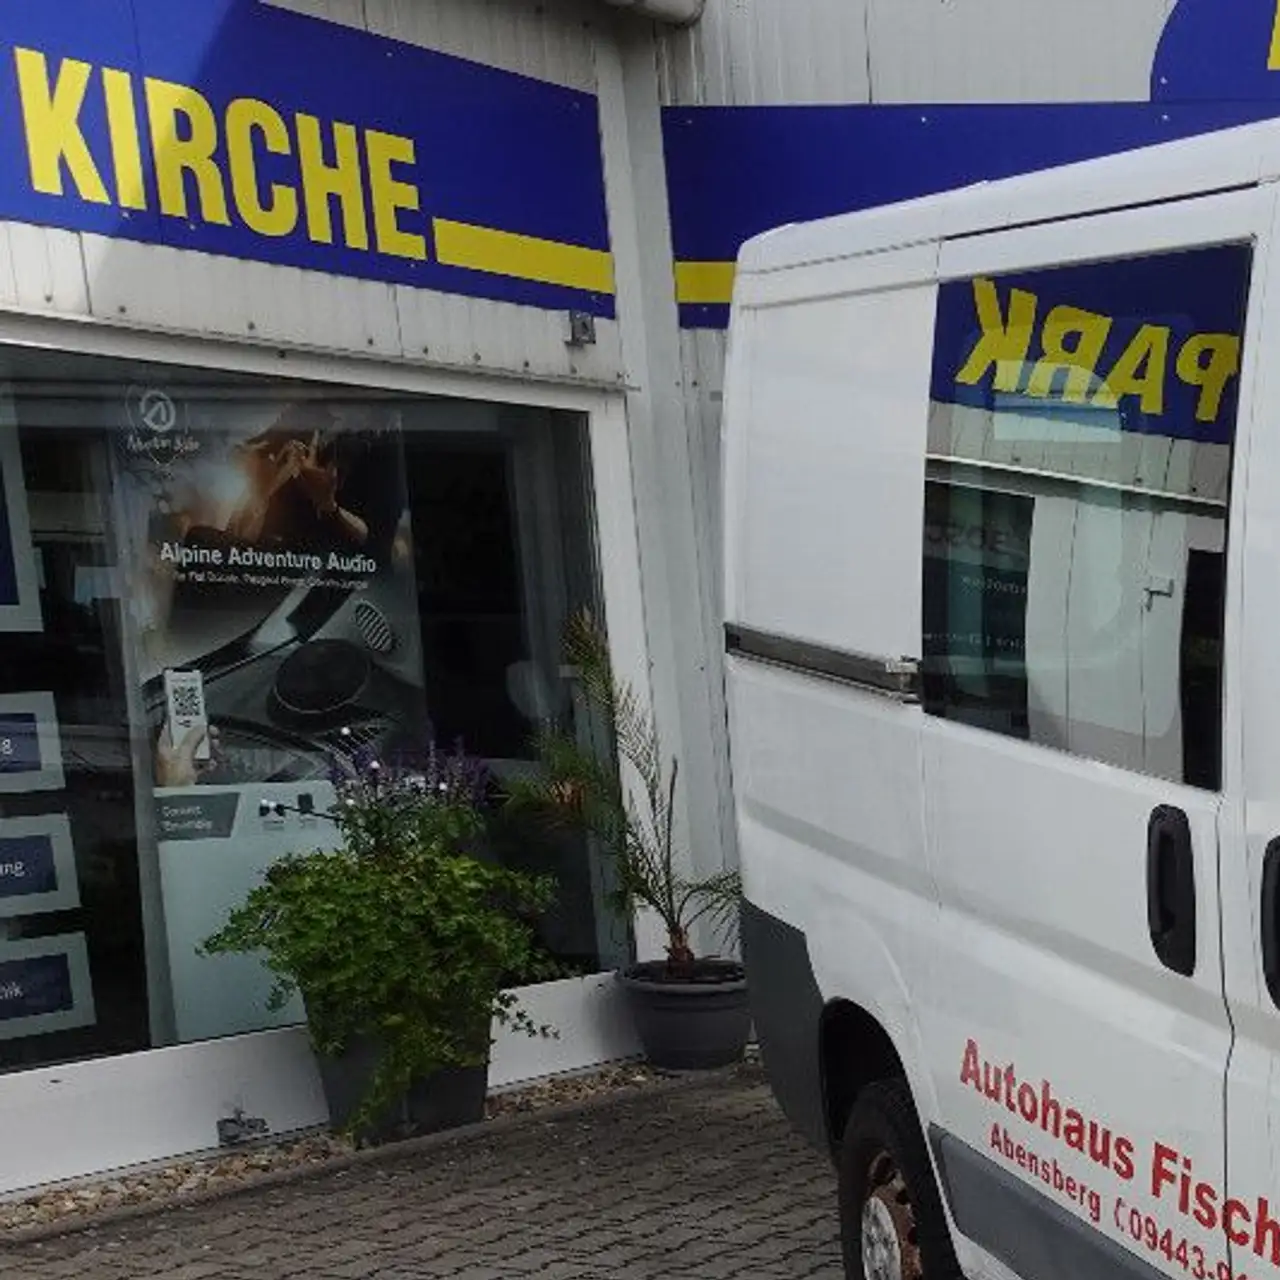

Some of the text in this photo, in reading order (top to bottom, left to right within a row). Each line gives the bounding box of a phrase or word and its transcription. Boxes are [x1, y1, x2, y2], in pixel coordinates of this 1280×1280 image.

[14, 46, 427, 261] KIRCHE
[160, 542, 376, 573] Alpine Adventure Audio
[960, 1038, 1137, 1180] Autohaus
[990, 1122, 1102, 1223] Abensberg
